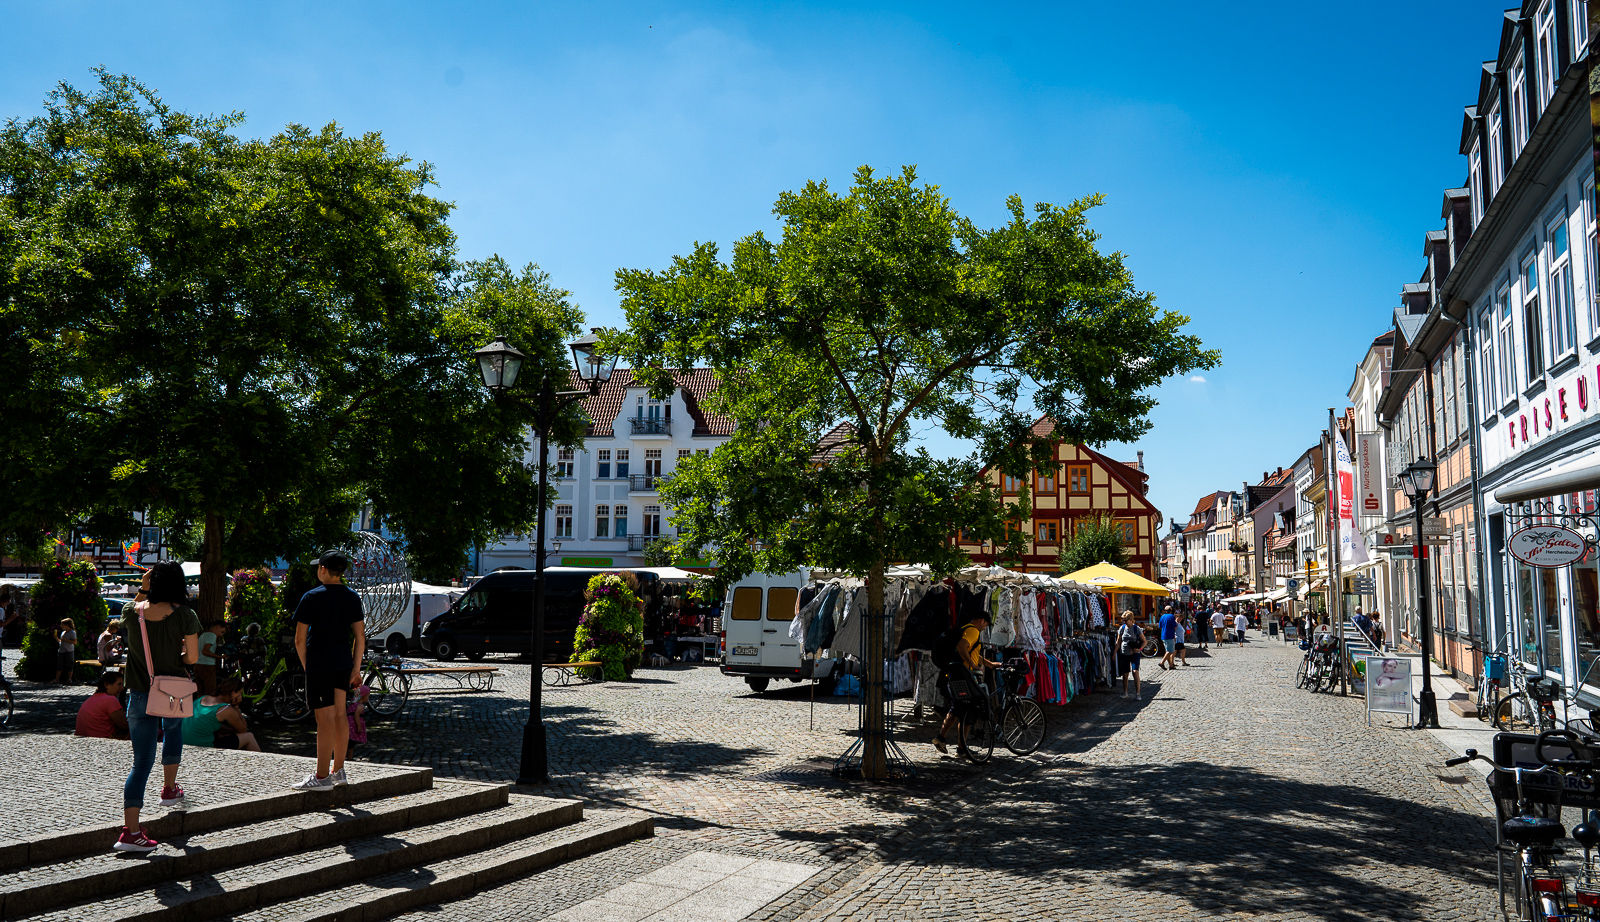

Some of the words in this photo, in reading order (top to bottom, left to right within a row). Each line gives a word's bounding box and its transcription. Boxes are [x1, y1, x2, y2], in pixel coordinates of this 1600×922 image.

[1508, 364, 1600, 449] FRISEU
[1524, 546, 1545, 560] Ihr
[1545, 538, 1580, 549] Salon
